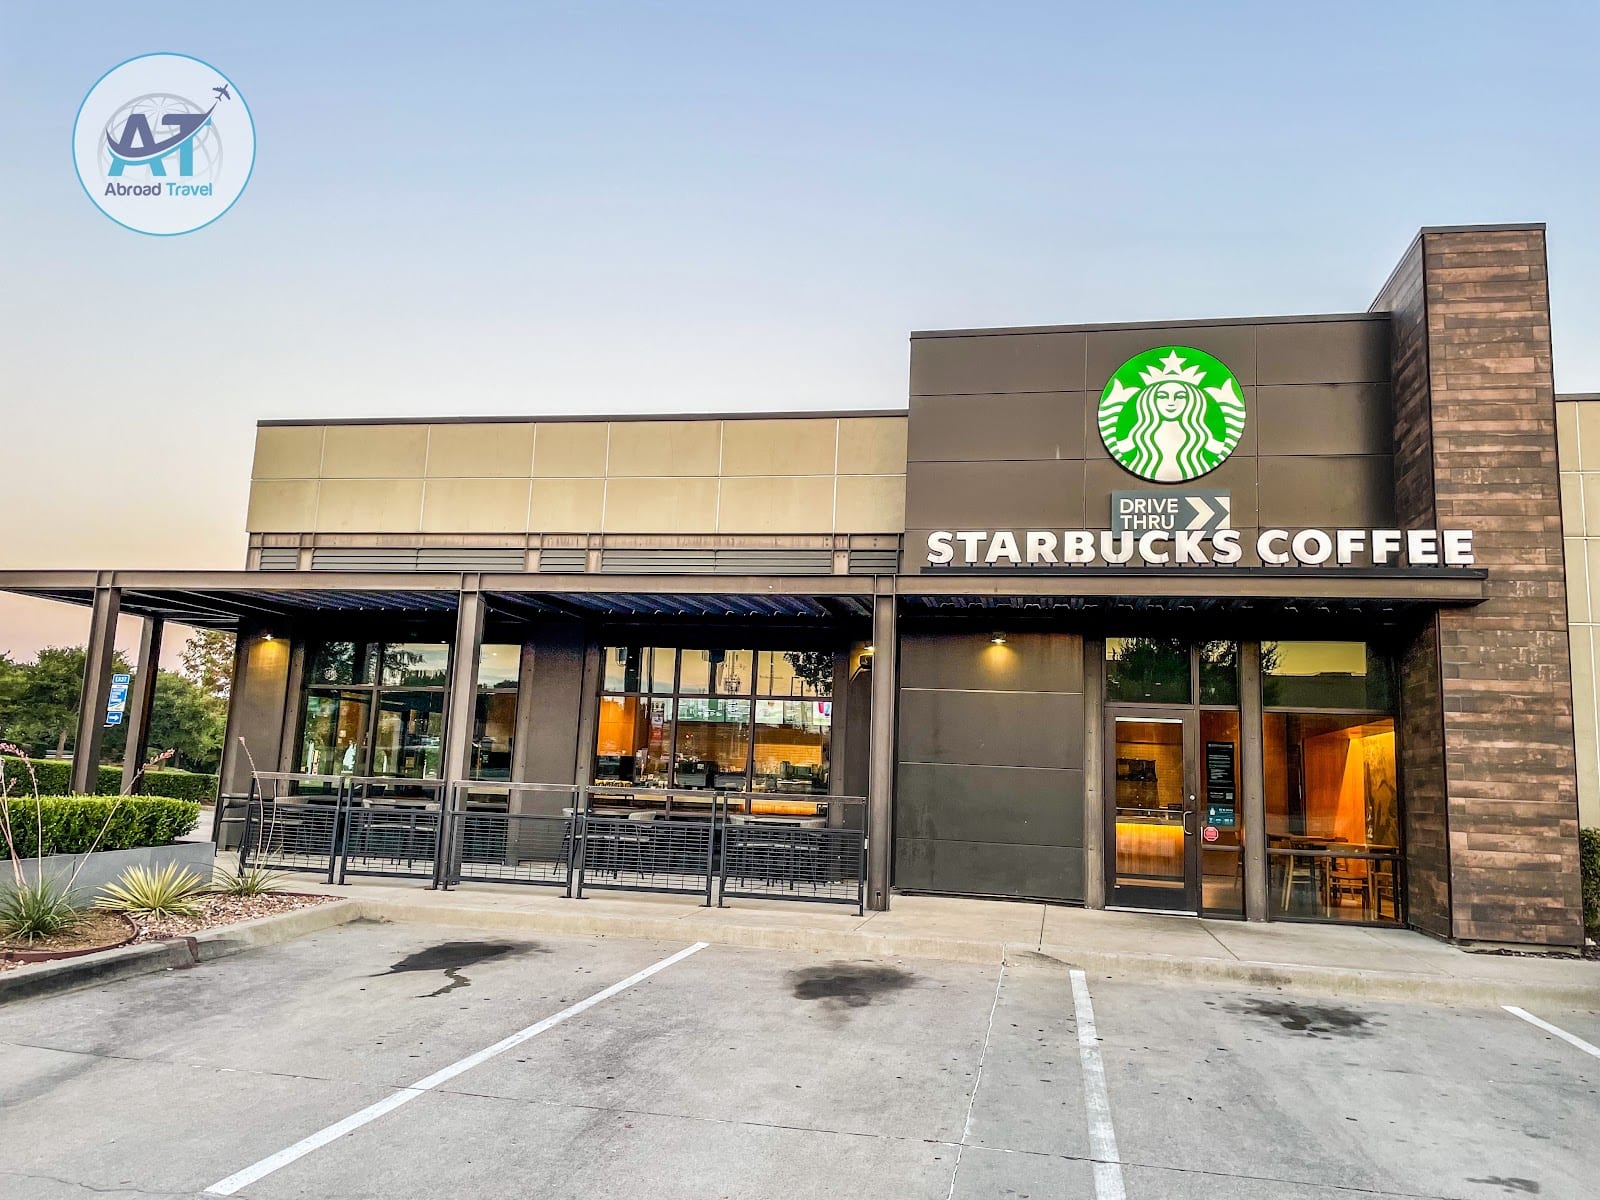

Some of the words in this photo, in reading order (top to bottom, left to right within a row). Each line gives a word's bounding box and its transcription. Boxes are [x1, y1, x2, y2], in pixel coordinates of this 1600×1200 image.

[1120, 498, 1178, 513] DRIVE
[1120, 514, 1175, 530] THRU
[926, 530, 1242, 564] STARBUCKS
[1256, 529, 1474, 565] COFFEE
